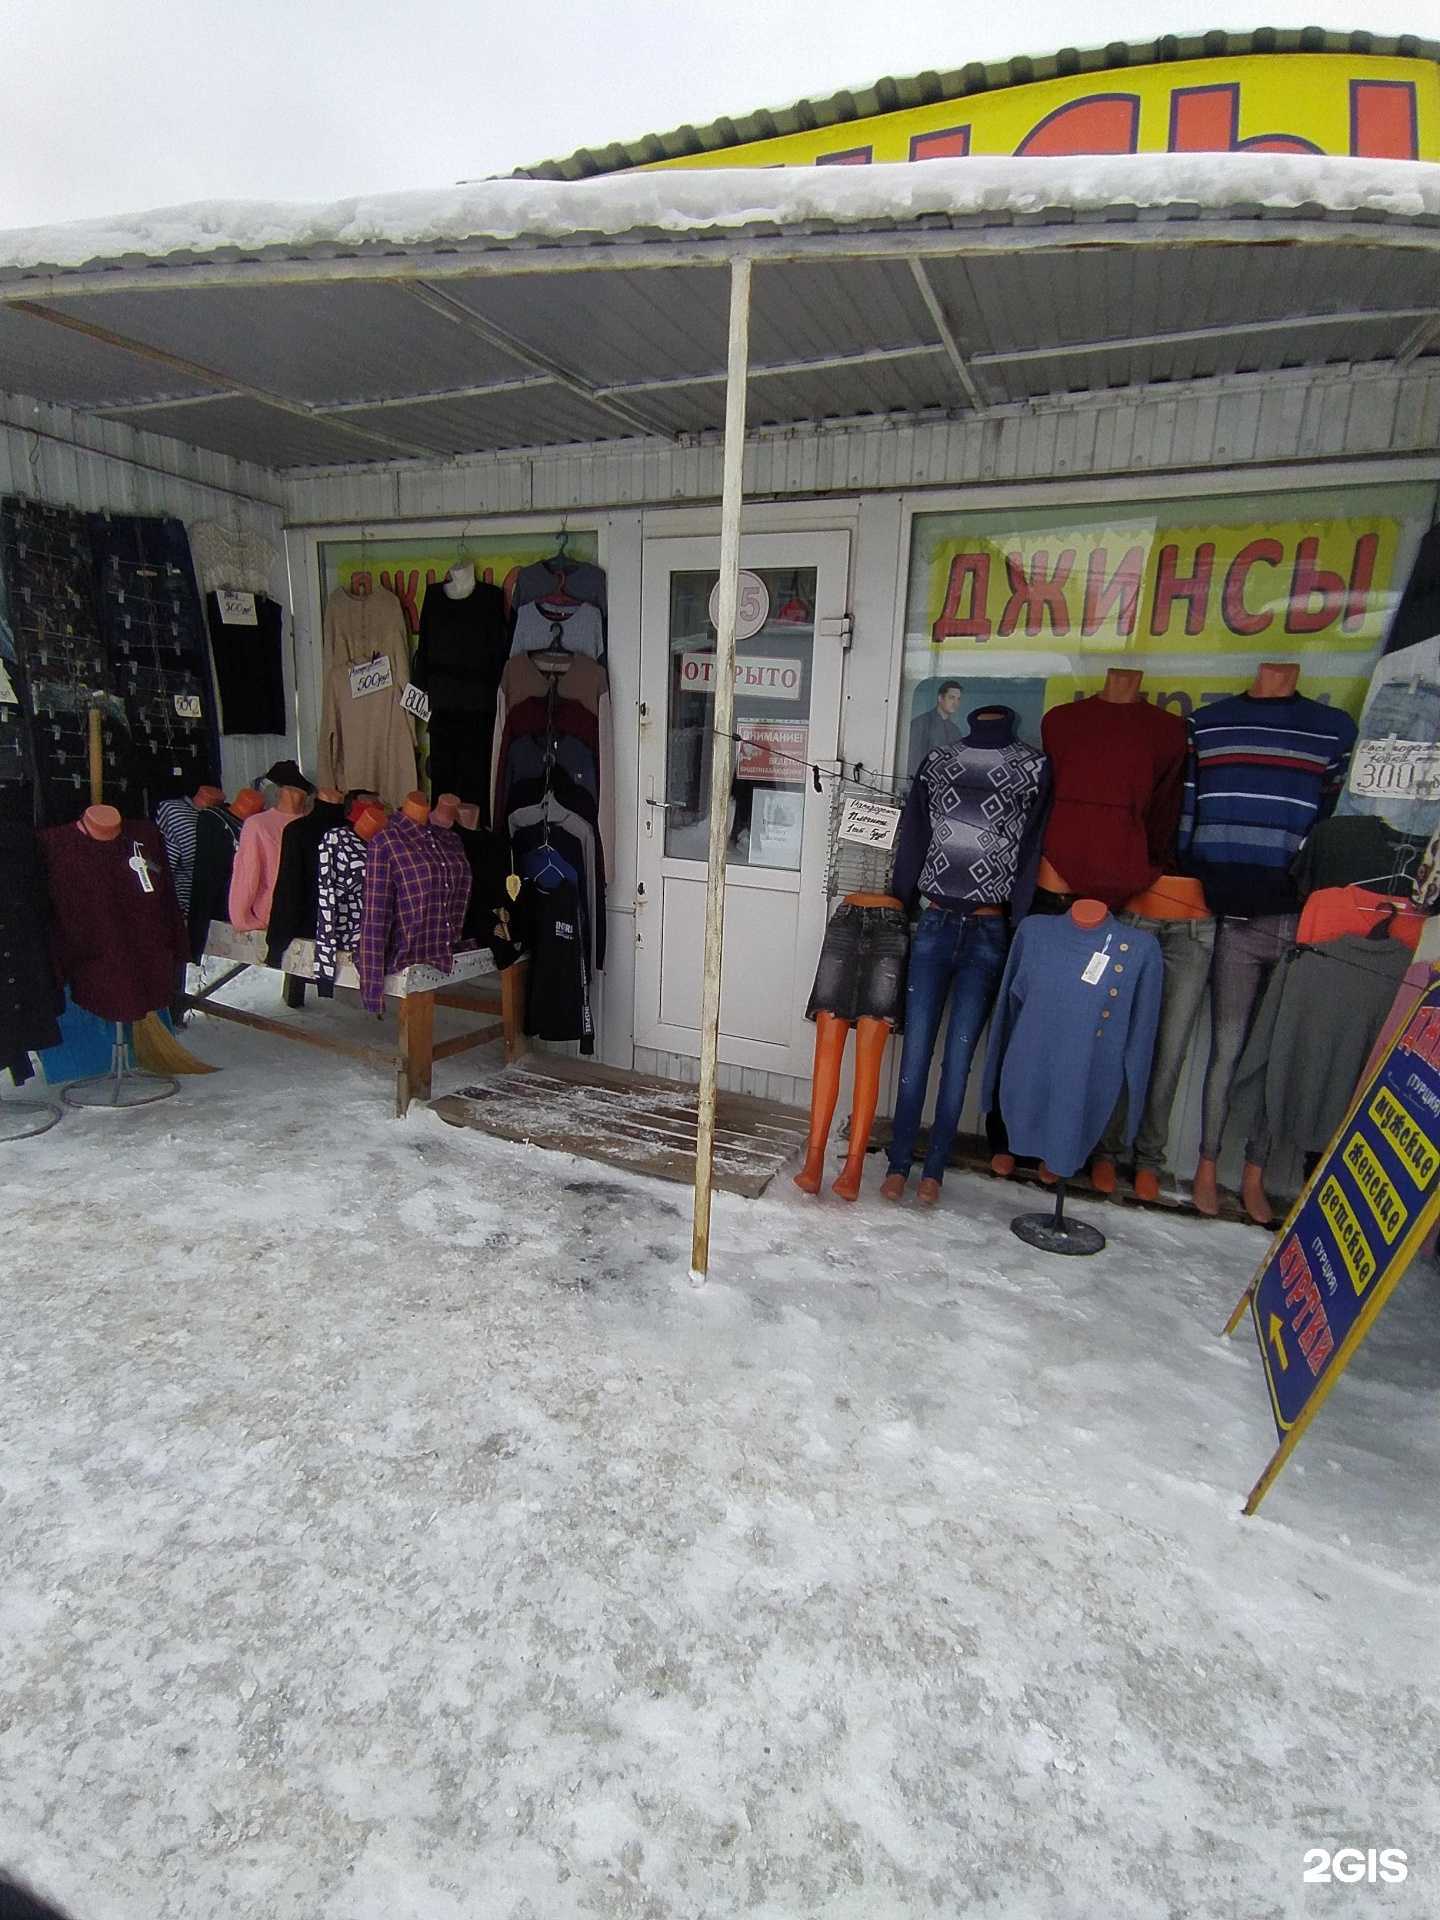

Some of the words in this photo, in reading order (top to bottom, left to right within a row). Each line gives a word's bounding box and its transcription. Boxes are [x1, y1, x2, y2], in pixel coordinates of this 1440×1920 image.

[932, 533, 1379, 643] ДЖИНСЫ
[685, 662, 798, 688] ОТРЫТО
[1280, 1233, 1335, 1376] КУРТКИ
